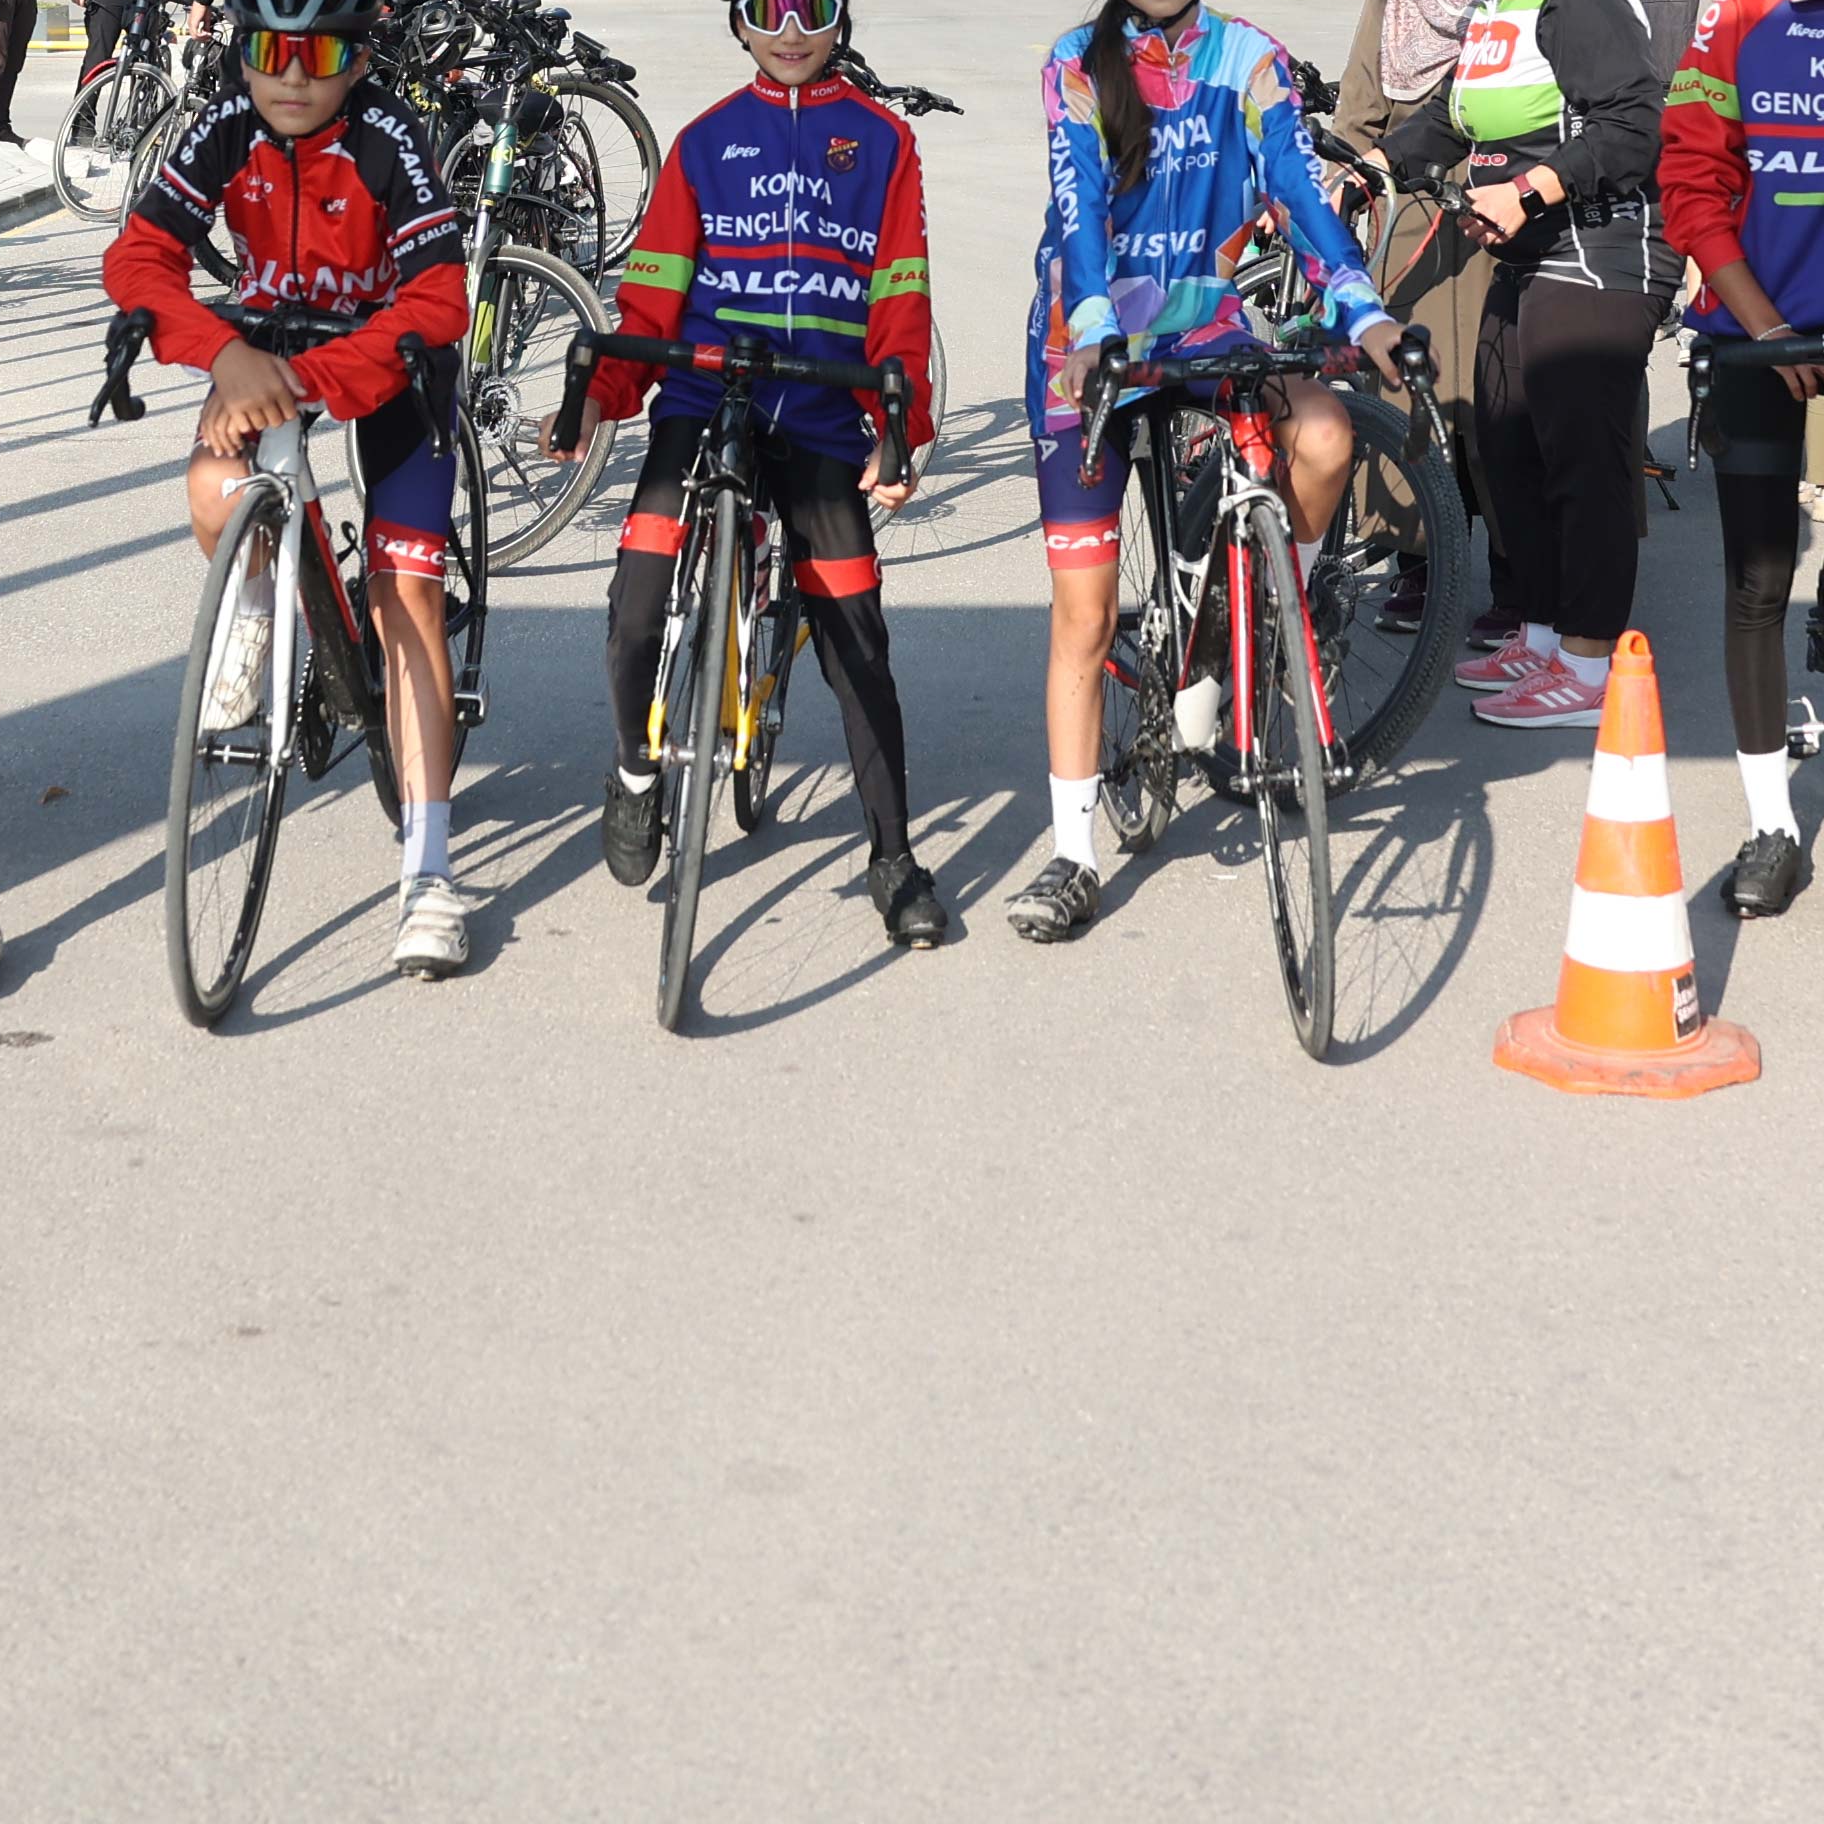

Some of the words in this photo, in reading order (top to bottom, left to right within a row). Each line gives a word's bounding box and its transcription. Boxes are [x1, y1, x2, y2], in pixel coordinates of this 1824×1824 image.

[749, 171, 833, 205] KONYA
[700, 202, 811, 241] GENÇLİK
[818, 217, 878, 257] SPOR
